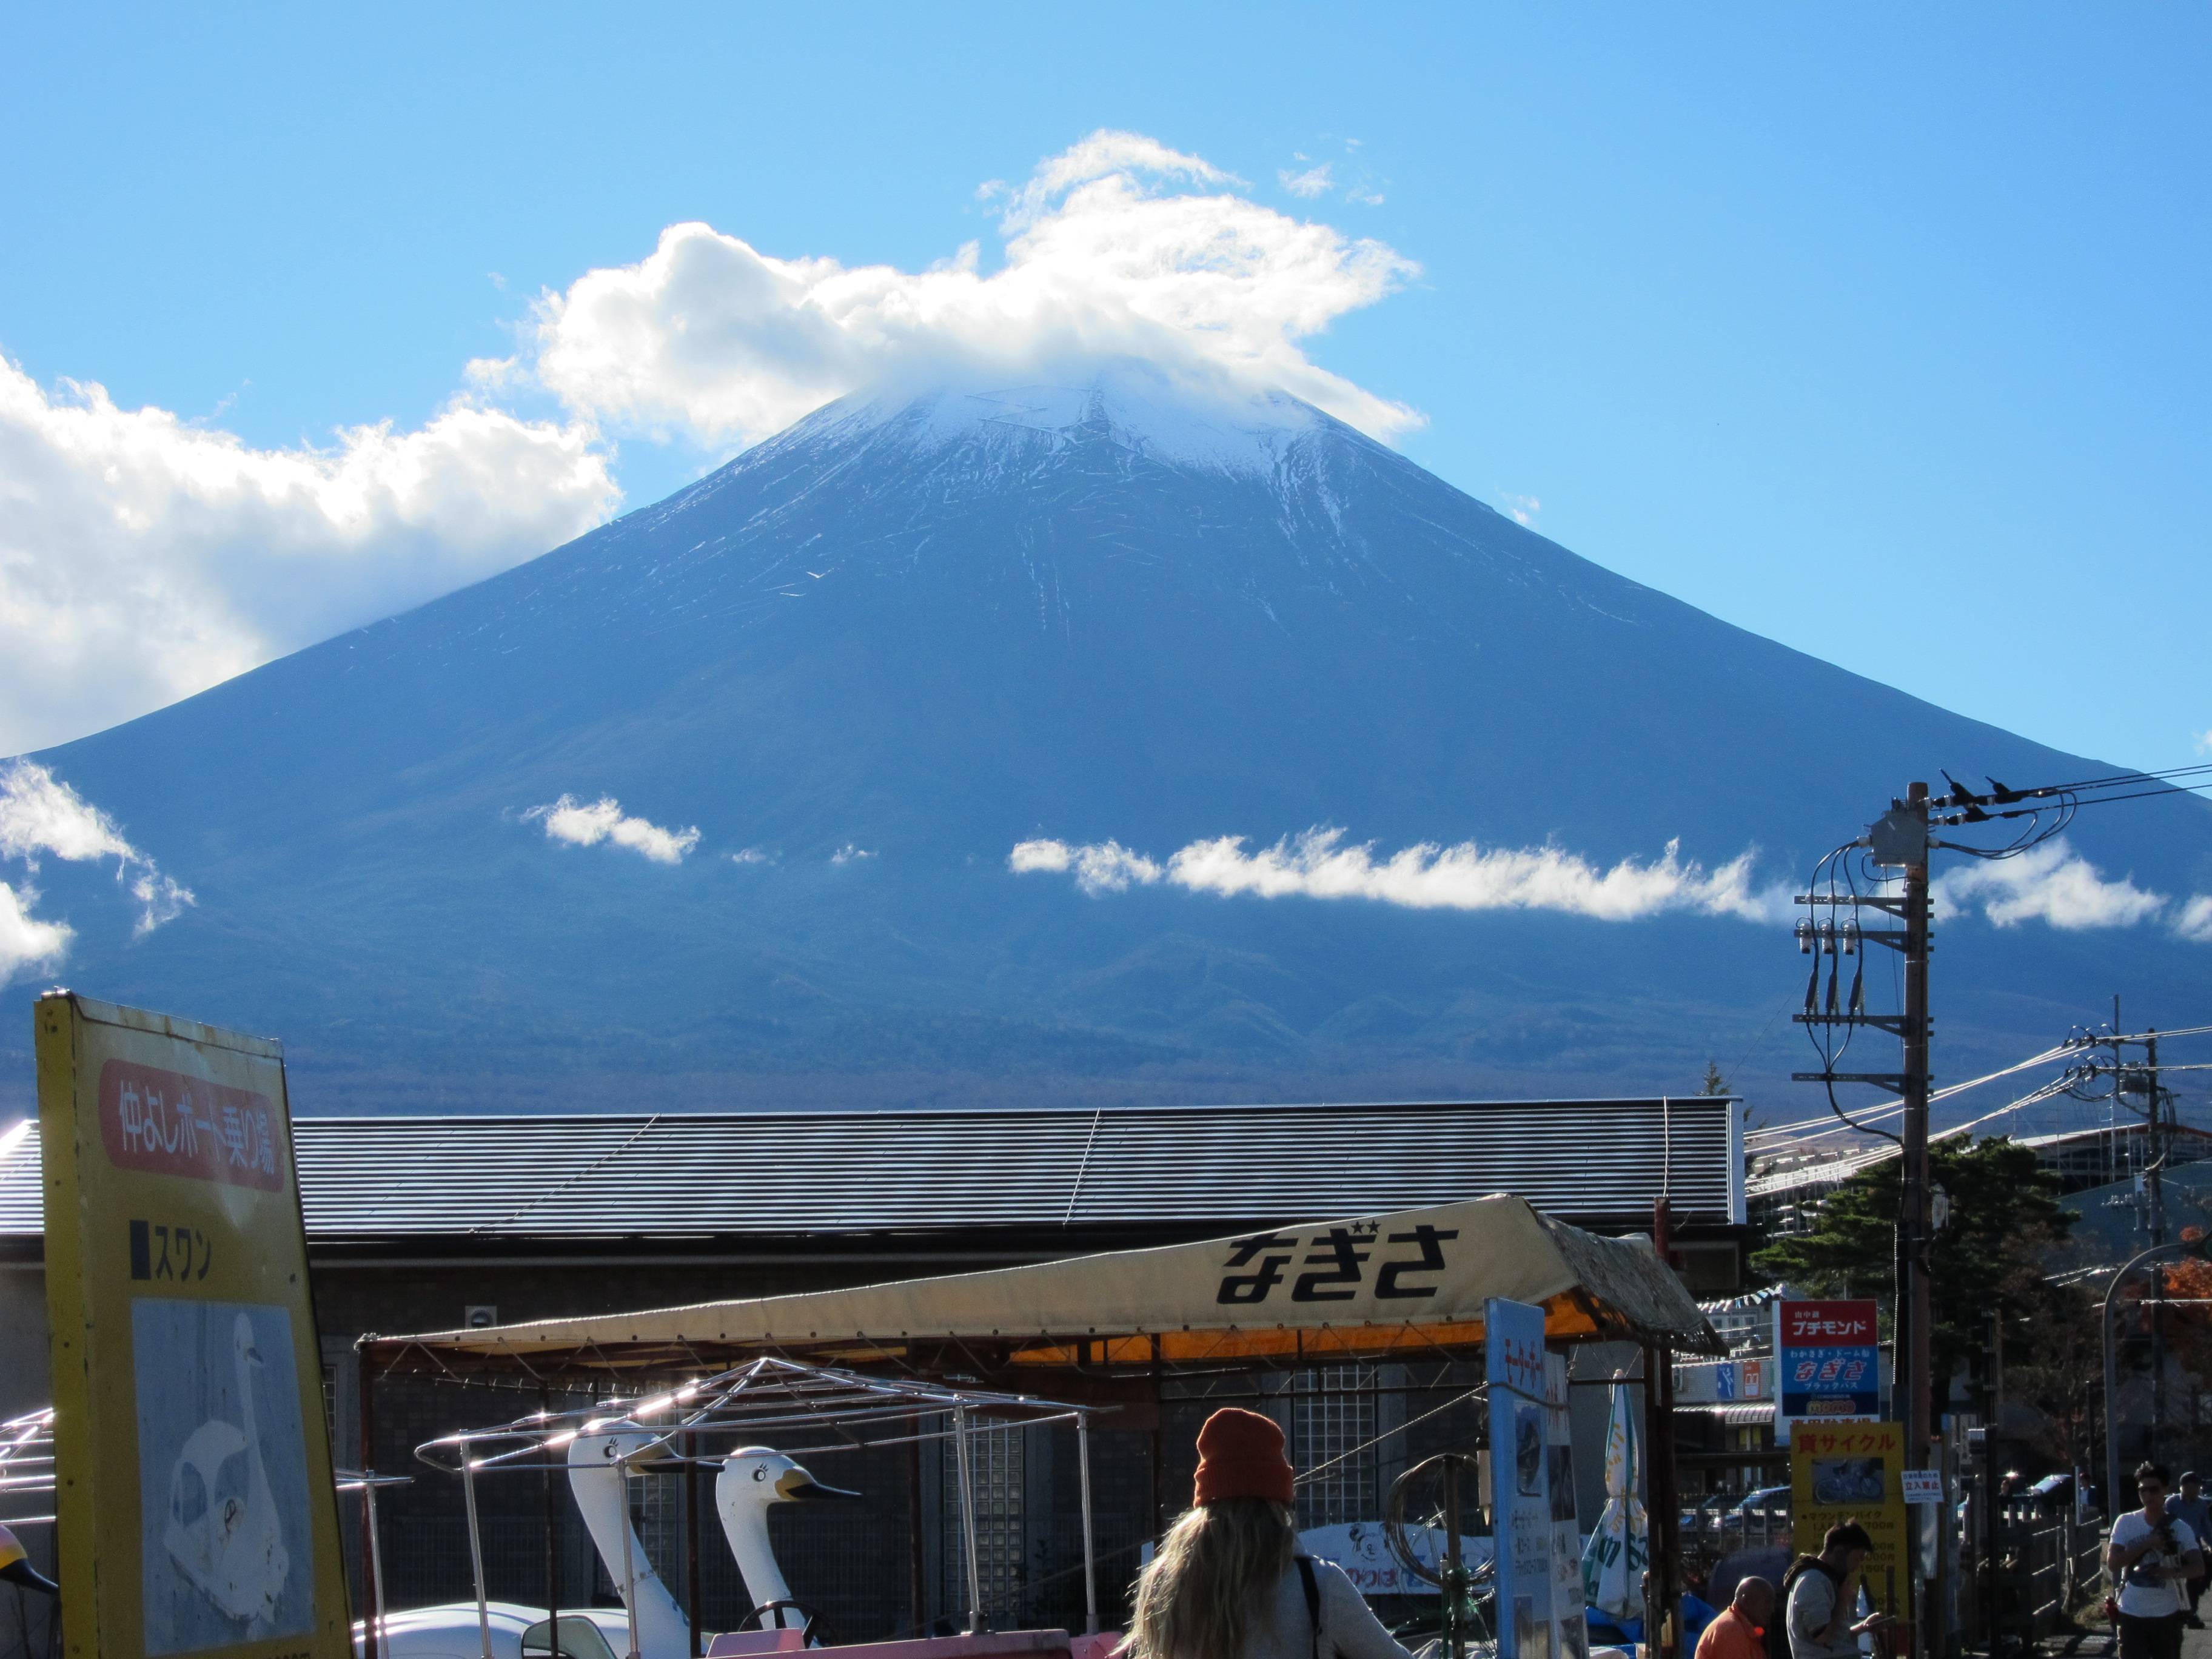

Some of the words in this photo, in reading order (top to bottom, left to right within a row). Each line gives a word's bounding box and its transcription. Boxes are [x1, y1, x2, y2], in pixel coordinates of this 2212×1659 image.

[119, 1079, 275, 1176] 仲よしボート乗り場
[1216, 1219, 1460, 1304] なぎさ
[1794, 1358, 1867, 1382] なぎさ
[1798, 1433, 1897, 1454] 貸サイクル
[1863, 1521, 1894, 1530] 700円
